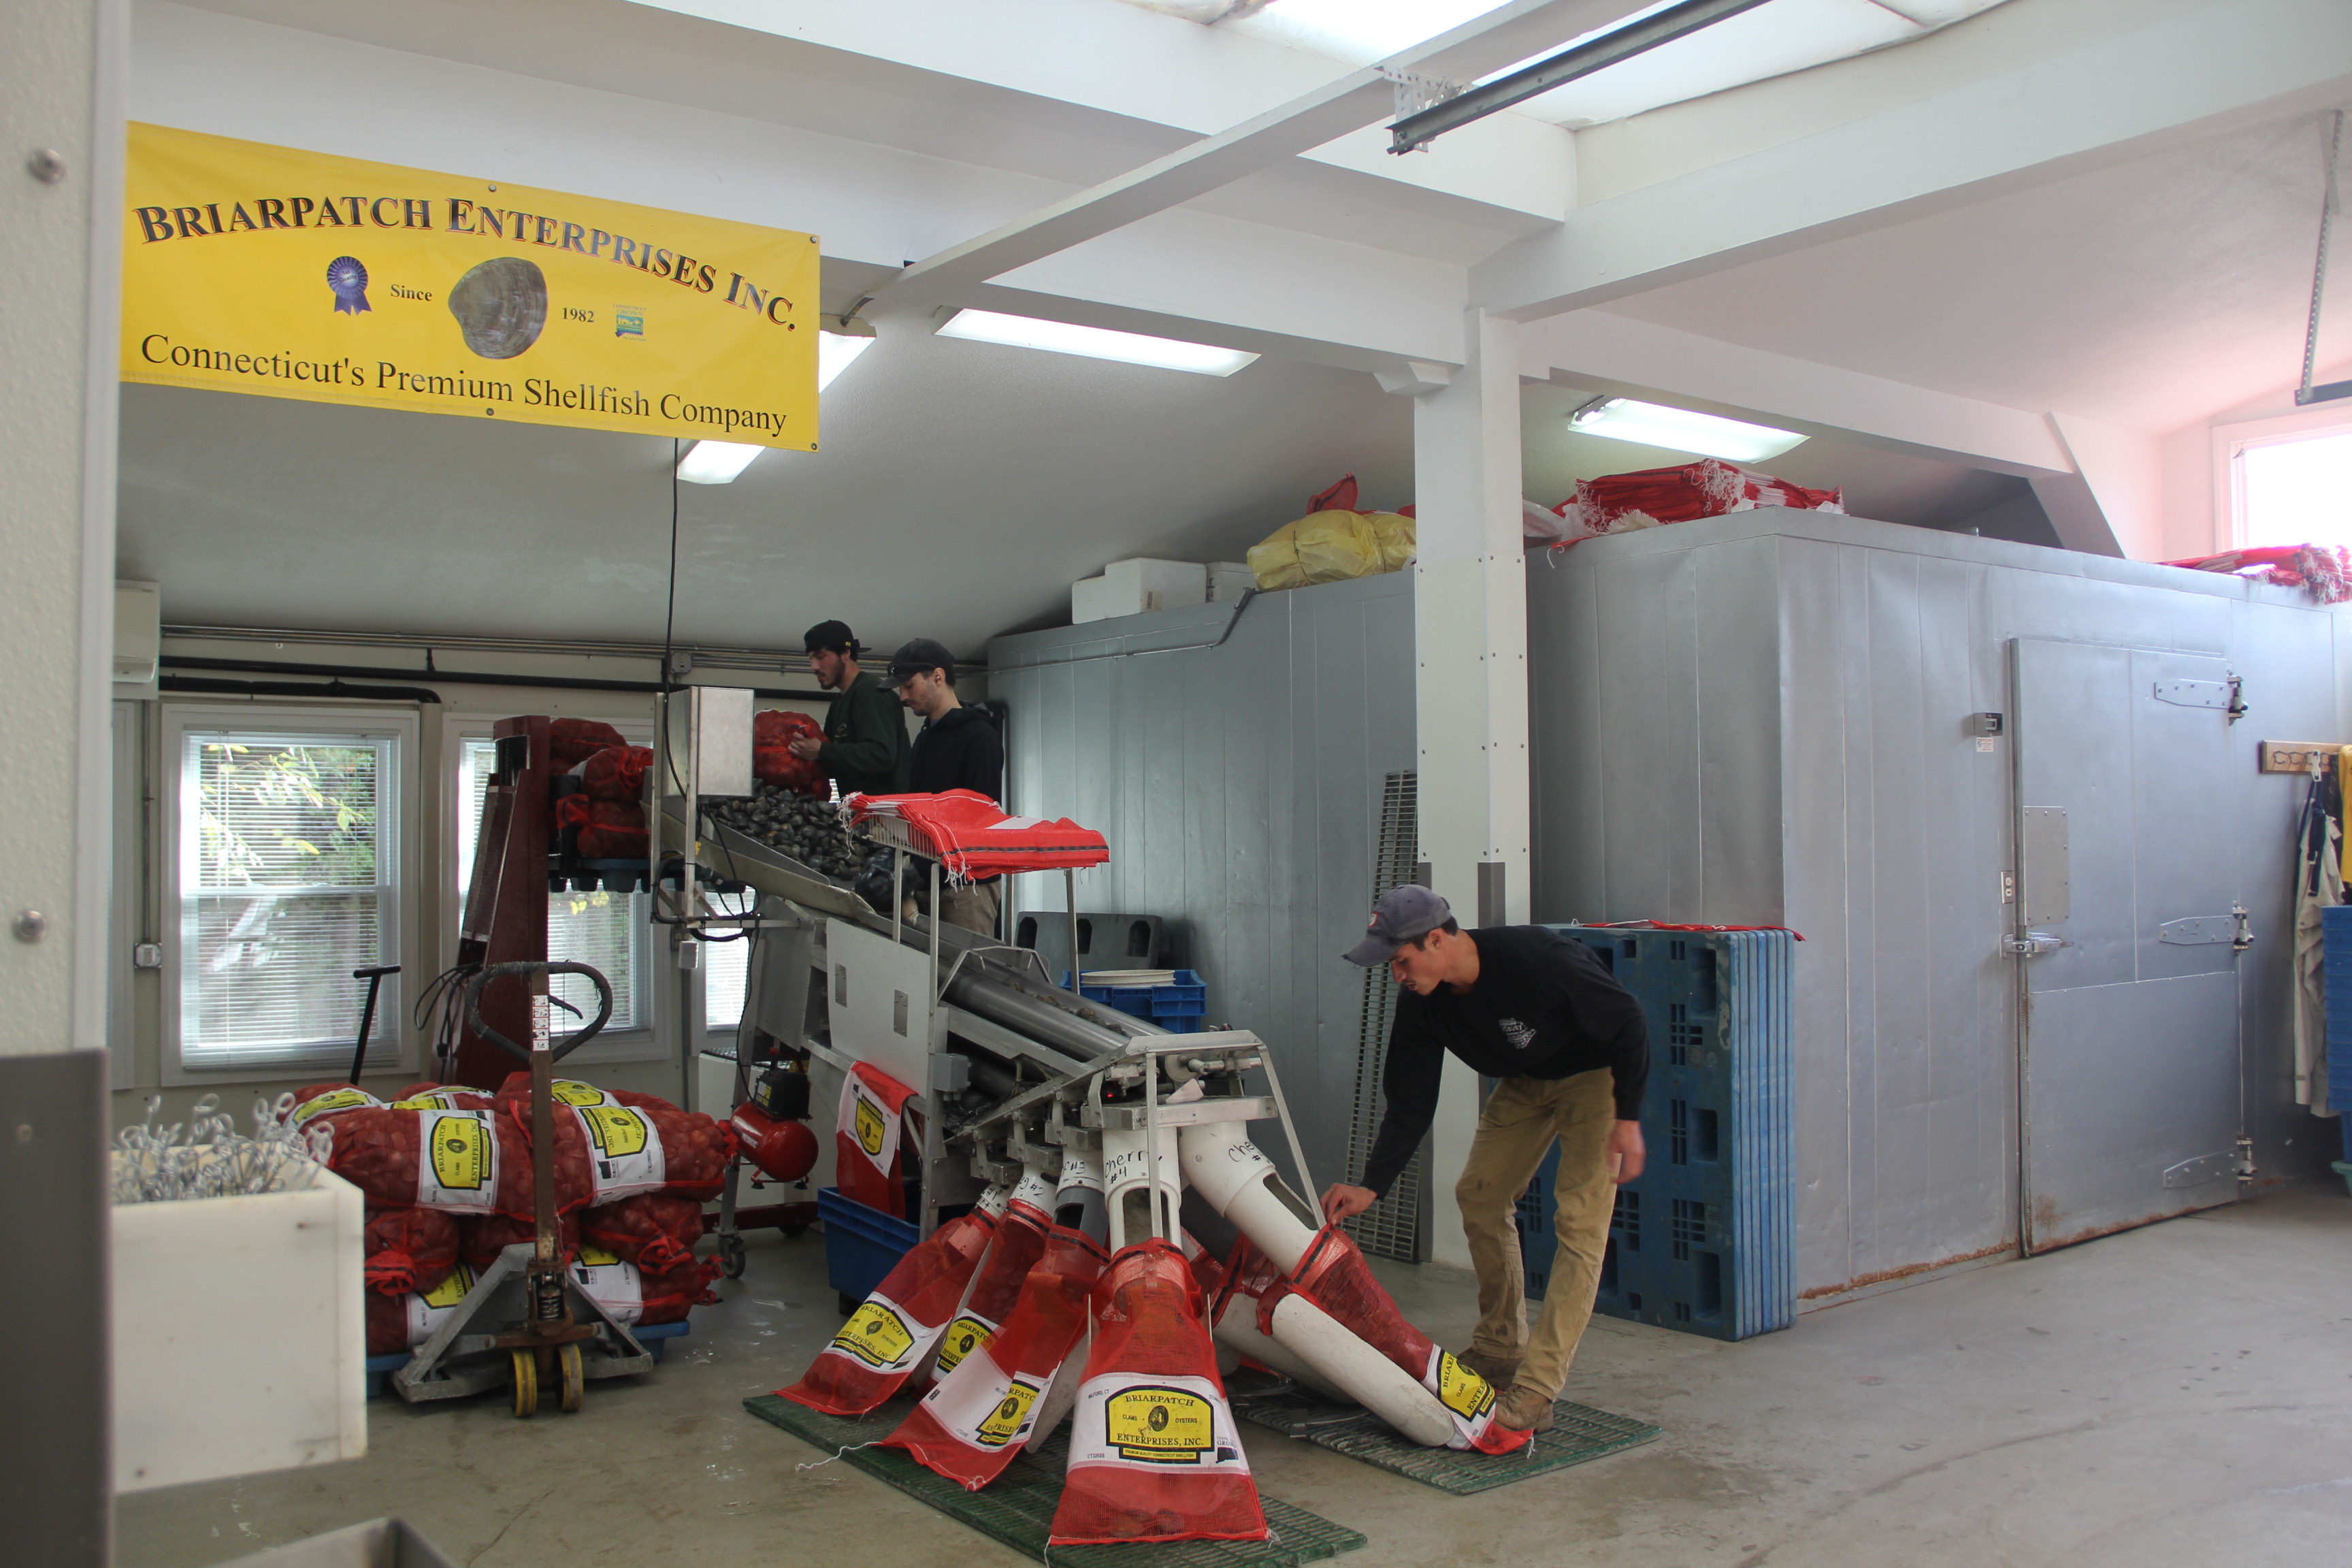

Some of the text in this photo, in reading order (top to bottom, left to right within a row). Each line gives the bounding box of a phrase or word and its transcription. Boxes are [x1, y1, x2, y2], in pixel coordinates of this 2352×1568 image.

[132, 196, 796, 331] BRIARPATCH ENTERPRISES INC.
[391, 283, 432, 301] Since
[562, 306, 595, 323] 1982
[142, 333, 787, 437] Connecticut's Premium Shellfish Company
[1070, 1161, 1086, 1175] #3
[1105, 1150, 1163, 1179] Cherr
[1109, 1166, 1127, 1185] #4
[1443, 1355, 1454, 1388] BRIARP
[1456, 1382, 1466, 1397] CLAMS
[1125, 1394, 1195, 1407] BRIARPATCH
[1117, 1433, 1181, 1446] ENTERPRISES,
[1184, 1438, 1204, 1446] INC.
